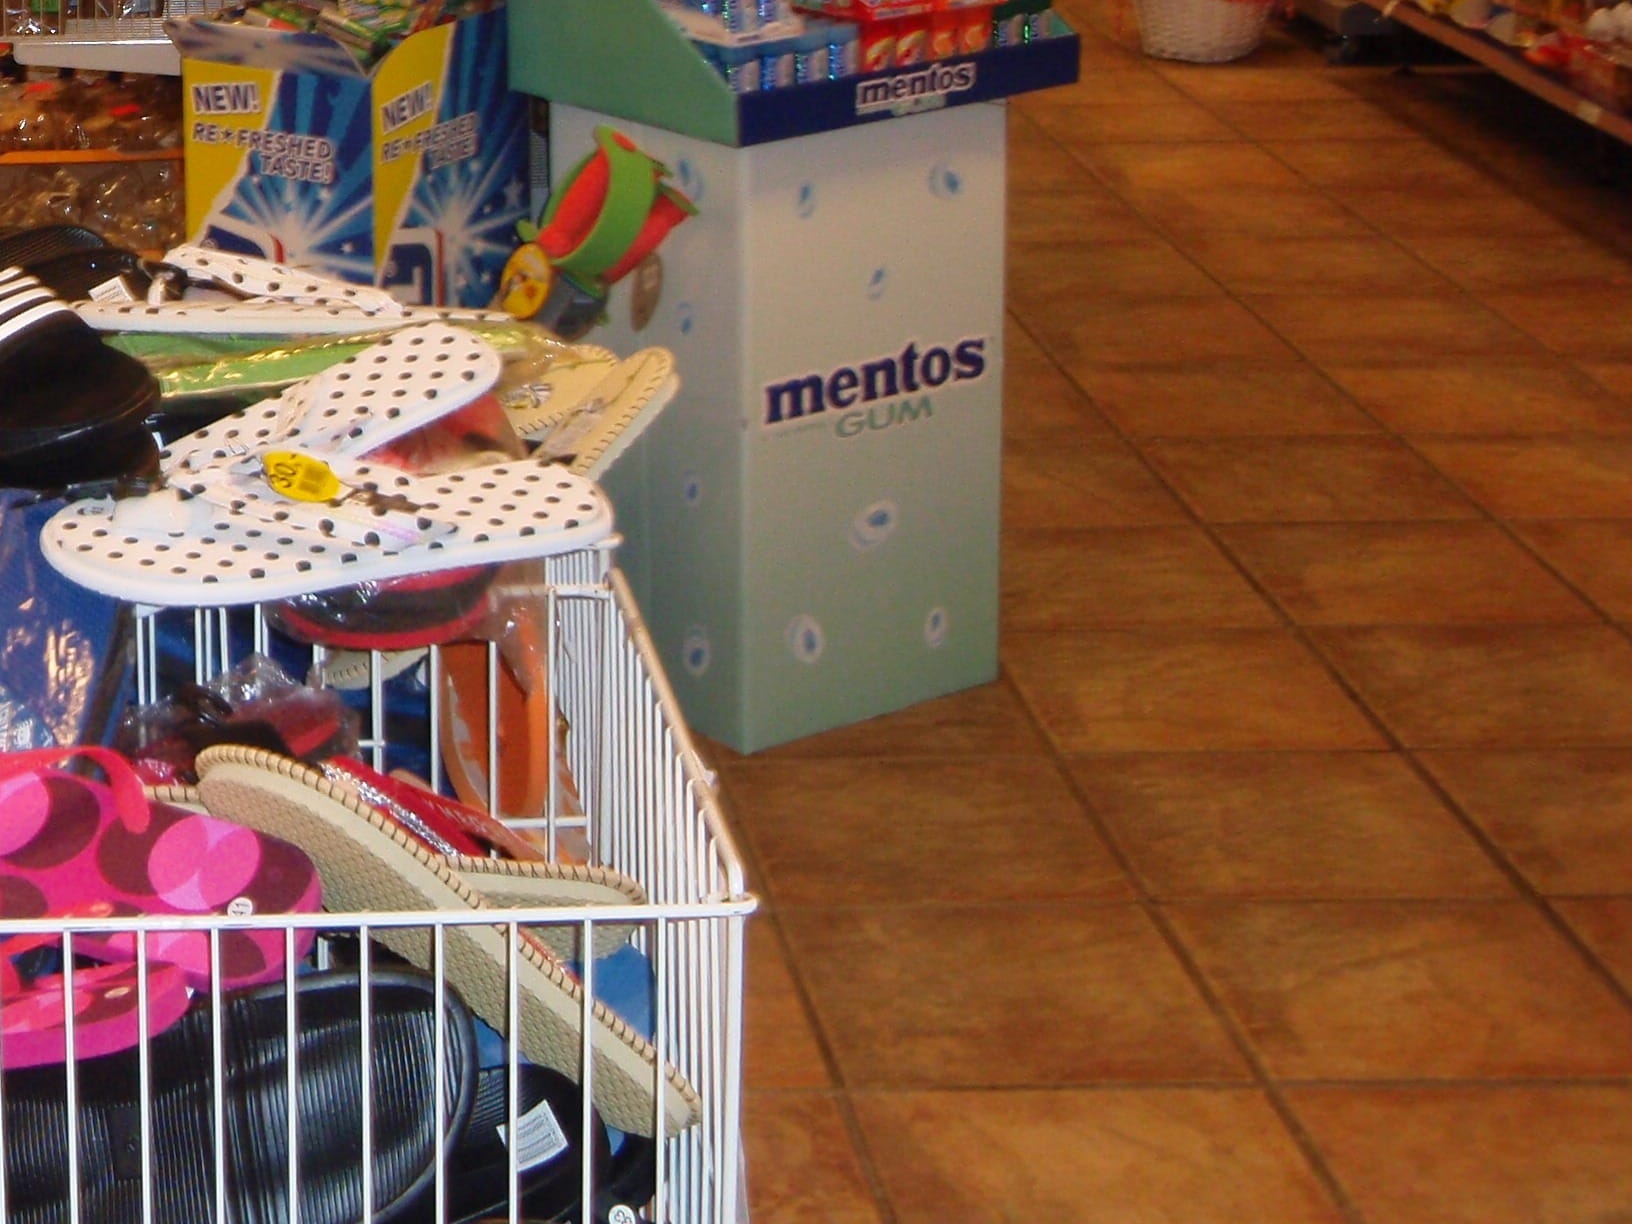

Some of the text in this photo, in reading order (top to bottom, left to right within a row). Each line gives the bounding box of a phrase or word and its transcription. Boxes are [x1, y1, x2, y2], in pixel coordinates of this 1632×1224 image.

[192, 83, 260, 114] NEW!
[380, 79, 433, 134] NEW!
[860, 62, 976, 108] mentos
[258, 152, 336, 186] TASTE!
[764, 337, 986, 425] mentos
[833, 395, 934, 439] GUM
